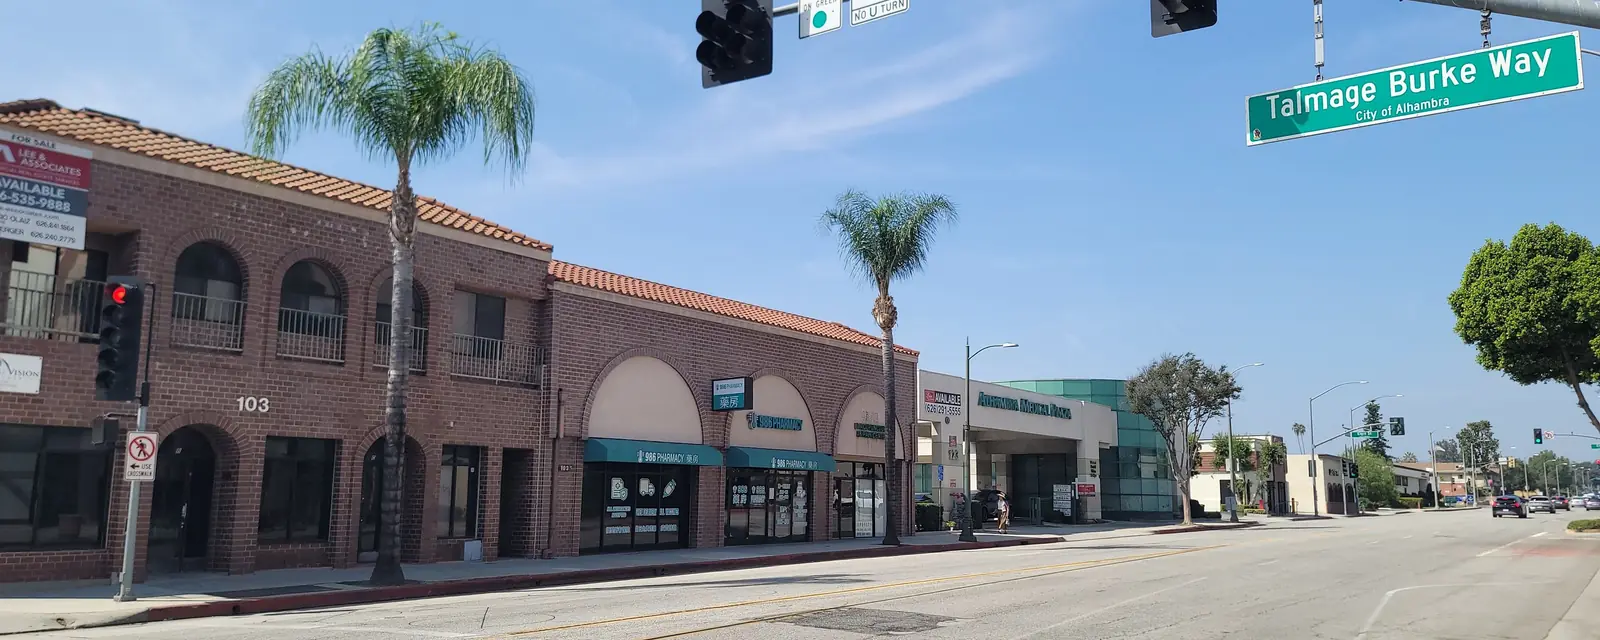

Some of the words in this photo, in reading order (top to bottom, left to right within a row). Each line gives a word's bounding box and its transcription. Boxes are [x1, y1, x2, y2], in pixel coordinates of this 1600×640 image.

[804, 4, 812, 12] ON
[816, 0, 836, 8] GRE
[854, 10, 866, 21] NO
[870, 6, 877, 17] U
[881, 0, 904, 13] TURN
[1266, 82, 1376, 119] Talmage
[1389, 61, 1477, 97] Burke
[1488, 48, 1552, 78] Way
[1356, 109, 1377, 121] City
[1381, 105, 1392, 117] of
[1396, 97, 1450, 114] Alhambra
[11, 134, 31, 143] FOR
[34, 139, 56, 149] SALE
[18, 148, 37, 159] LEE
[38, 152, 46, 160] &
[20, 158, 82, 176] ASSOCIATES
[236, 396, 270, 412] 103
[935, 392, 961, 404] AVAILABLE
[645, 452, 656, 461] 986
[657, 453, 684, 463] PHARMACY
[786, 460, 806, 469] PHARMACY
